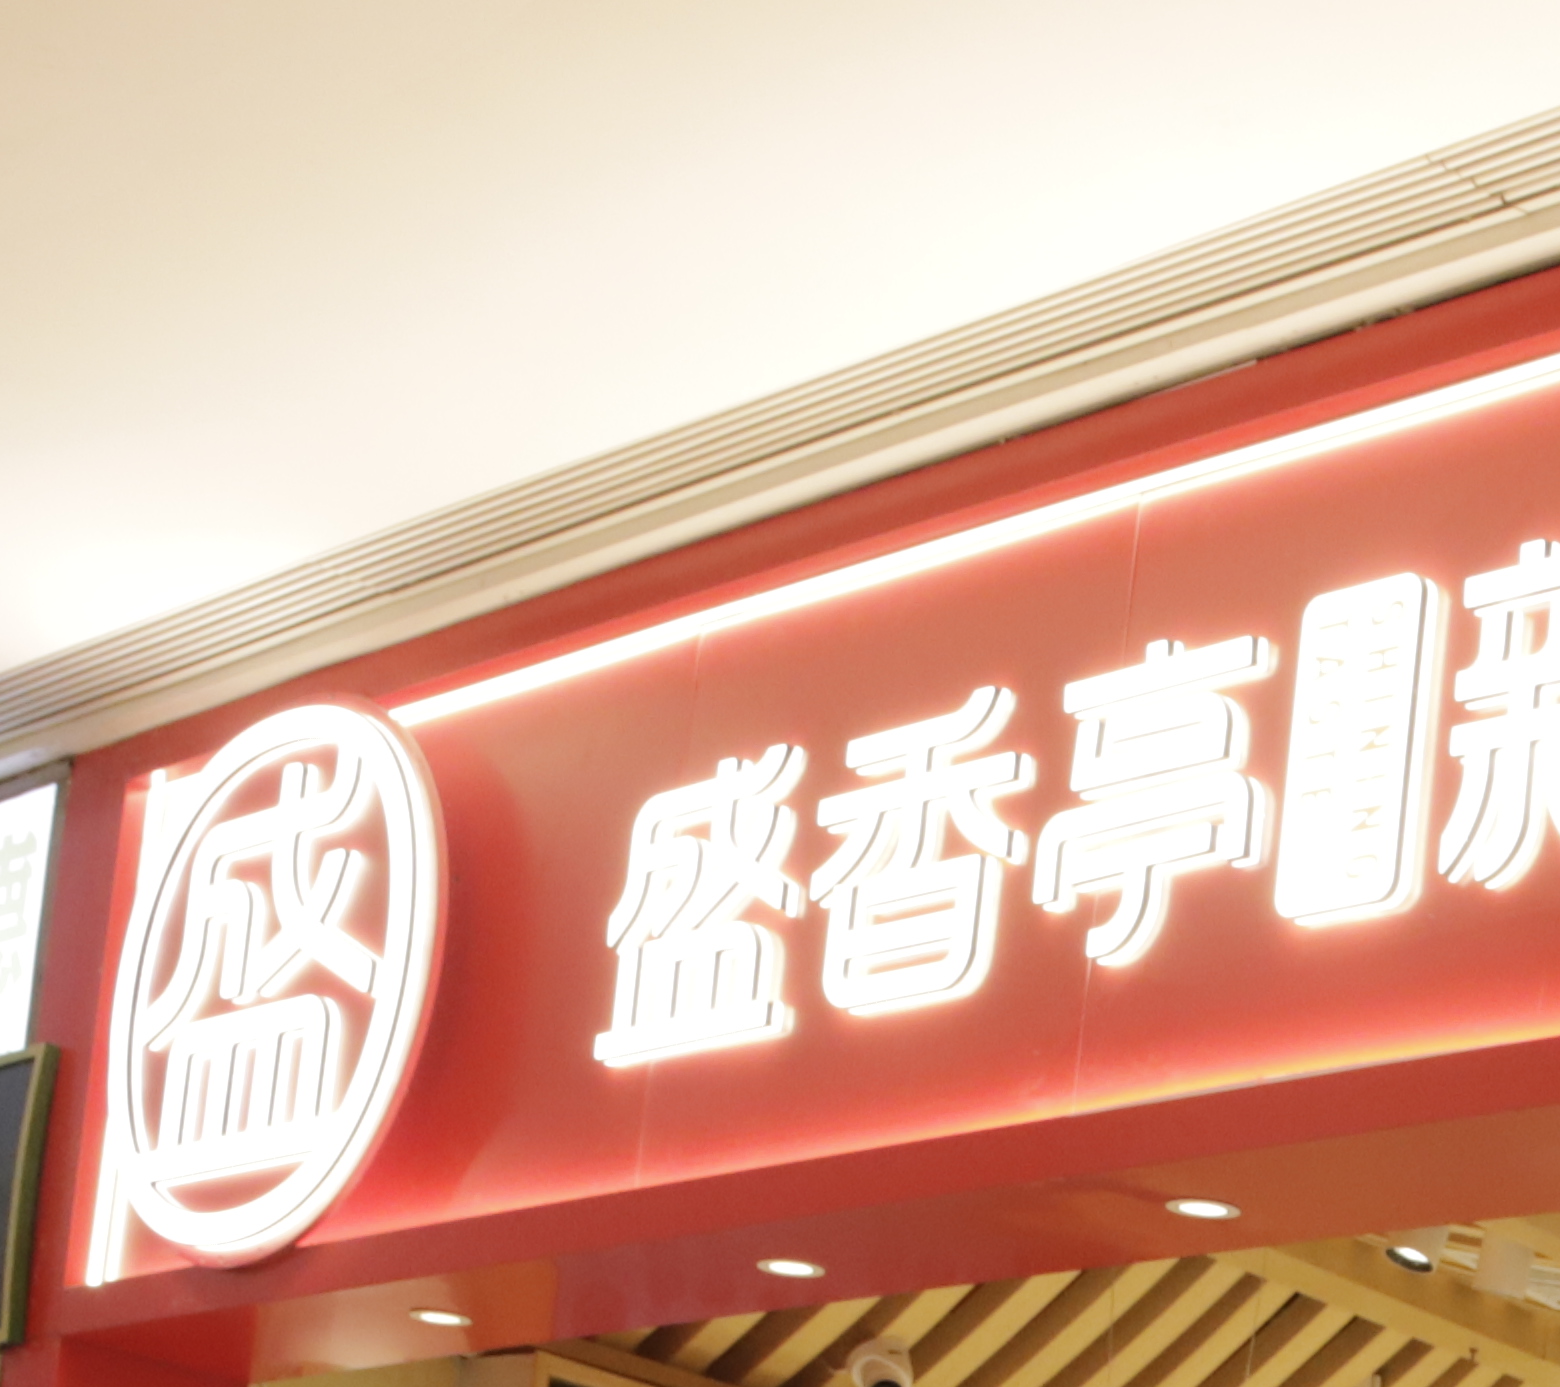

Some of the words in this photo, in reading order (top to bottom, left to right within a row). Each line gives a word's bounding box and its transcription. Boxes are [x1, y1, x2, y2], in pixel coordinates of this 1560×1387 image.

[130, 735, 385, 1190] 盛
[594, 635, 1278, 1069] 盛香亭
